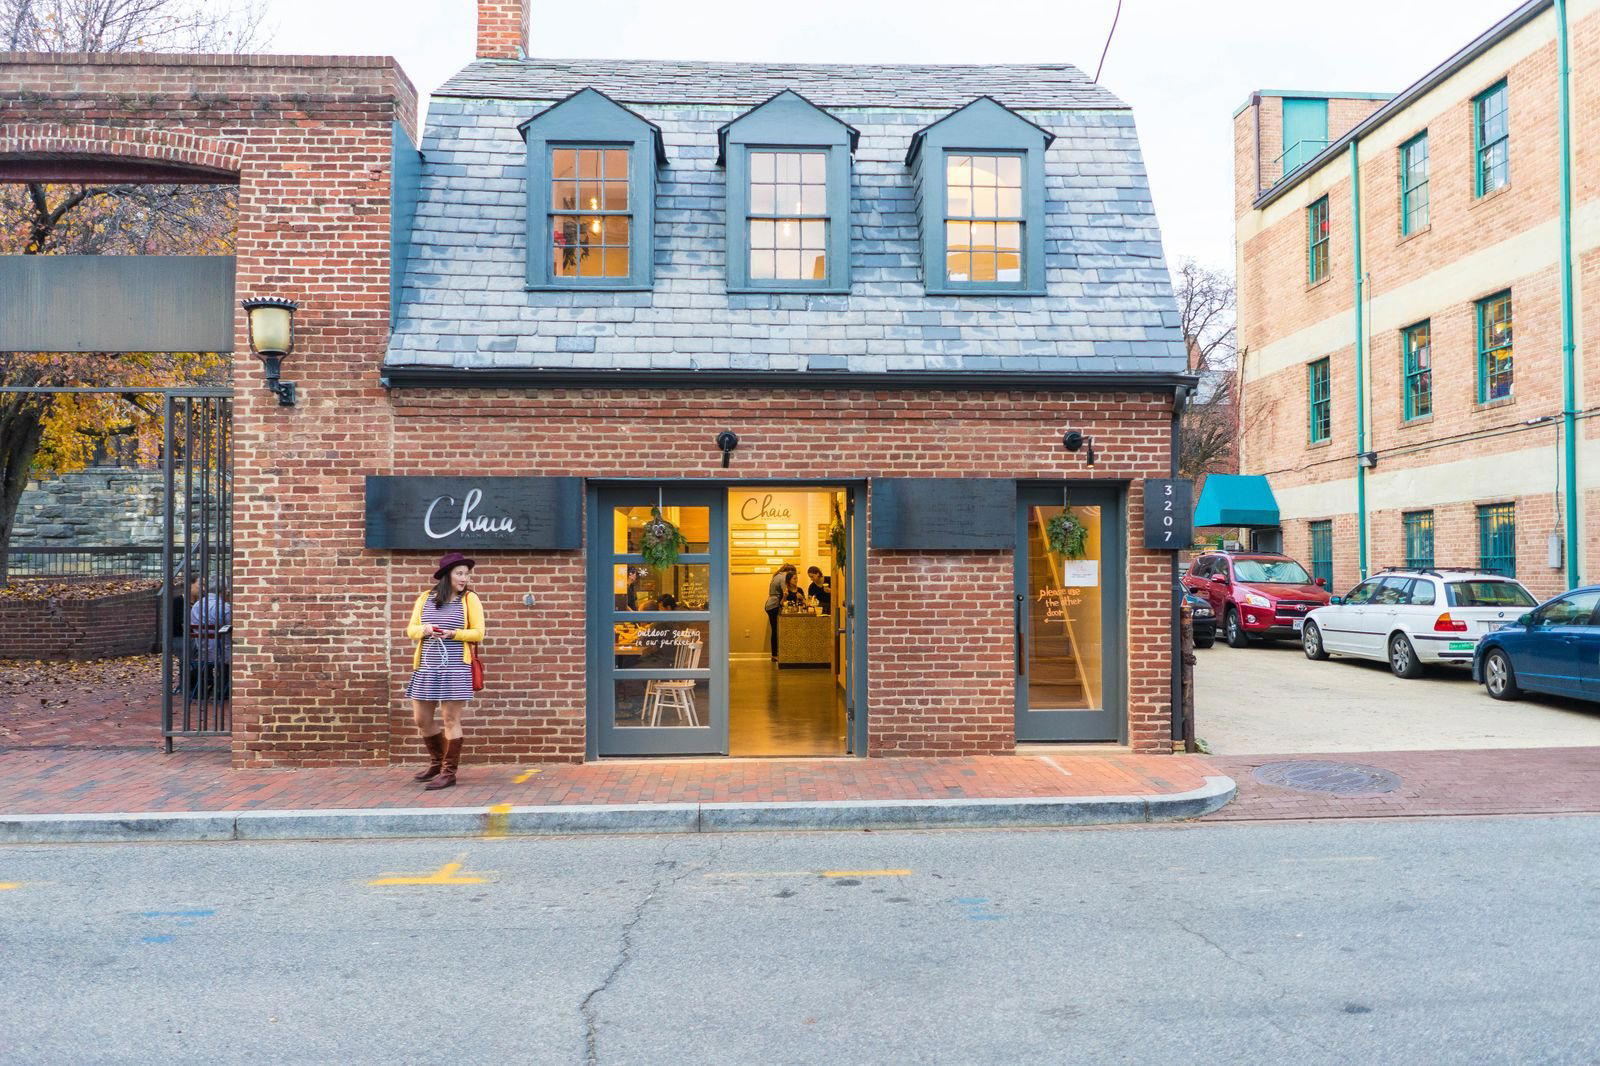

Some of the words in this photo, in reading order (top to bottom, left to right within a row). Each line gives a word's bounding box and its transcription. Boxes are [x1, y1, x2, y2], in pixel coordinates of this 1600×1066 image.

[741, 494, 792, 521] Chaia
[1163, 485, 1173, 541] 3207
[1037, 585, 1066, 602] please
[1068, 588, 1080, 596] use
[1045, 598, 1059, 607] the
[1060, 595, 1082, 607] other
[1046, 608, 1064, 617] door
[637, 628, 670, 638] outdoor
